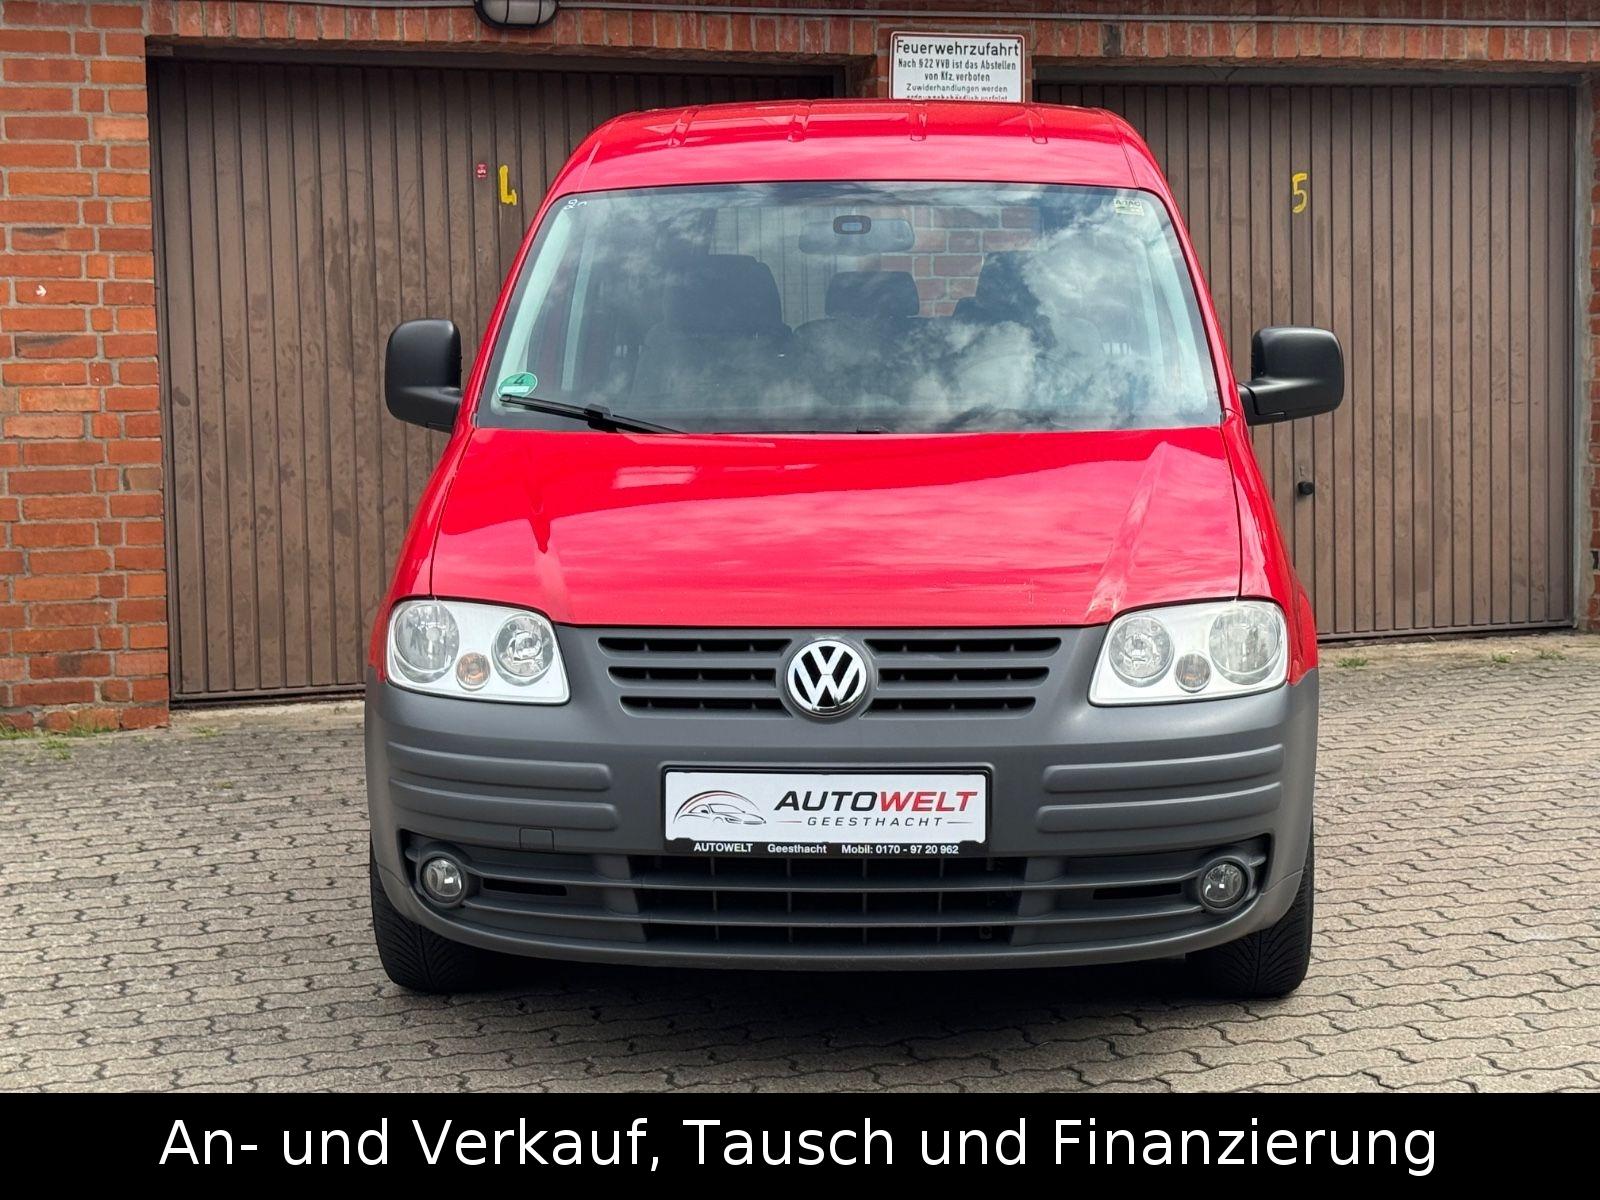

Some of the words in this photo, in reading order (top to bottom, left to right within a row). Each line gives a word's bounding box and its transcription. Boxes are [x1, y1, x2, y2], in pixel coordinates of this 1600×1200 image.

[896, 40, 1019, 57] Feuerwehrzufahrt
[898, 58, 917, 69] Nach
[952, 59, 963, 70] ist
[965, 60, 978, 70] das
[980, 60, 1017, 71] Abstellen
[924, 72, 939, 81] von
[956, 72, 990, 82] verboten
[906, 83, 980, 94] Zuwiderhandlungen
[981, 85, 1008, 93] werden
[1292, 172, 1308, 214] 5
[513, 373, 526, 386] 4
[788, 641, 867, 712] VW
[774, 790, 978, 812] AUTOWELT
[807, 816, 943, 827] GEESTHACHT
[694, 842, 754, 853] AUTOWELT
[767, 843, 828, 854] Geesthacht
[841, 844, 873, 854] Mobil:
[875, 844, 900, 854] 0170
[910, 844, 923, 854] 97
[925, 845, 938, 854] 20
[940, 845, 959, 855] 962
